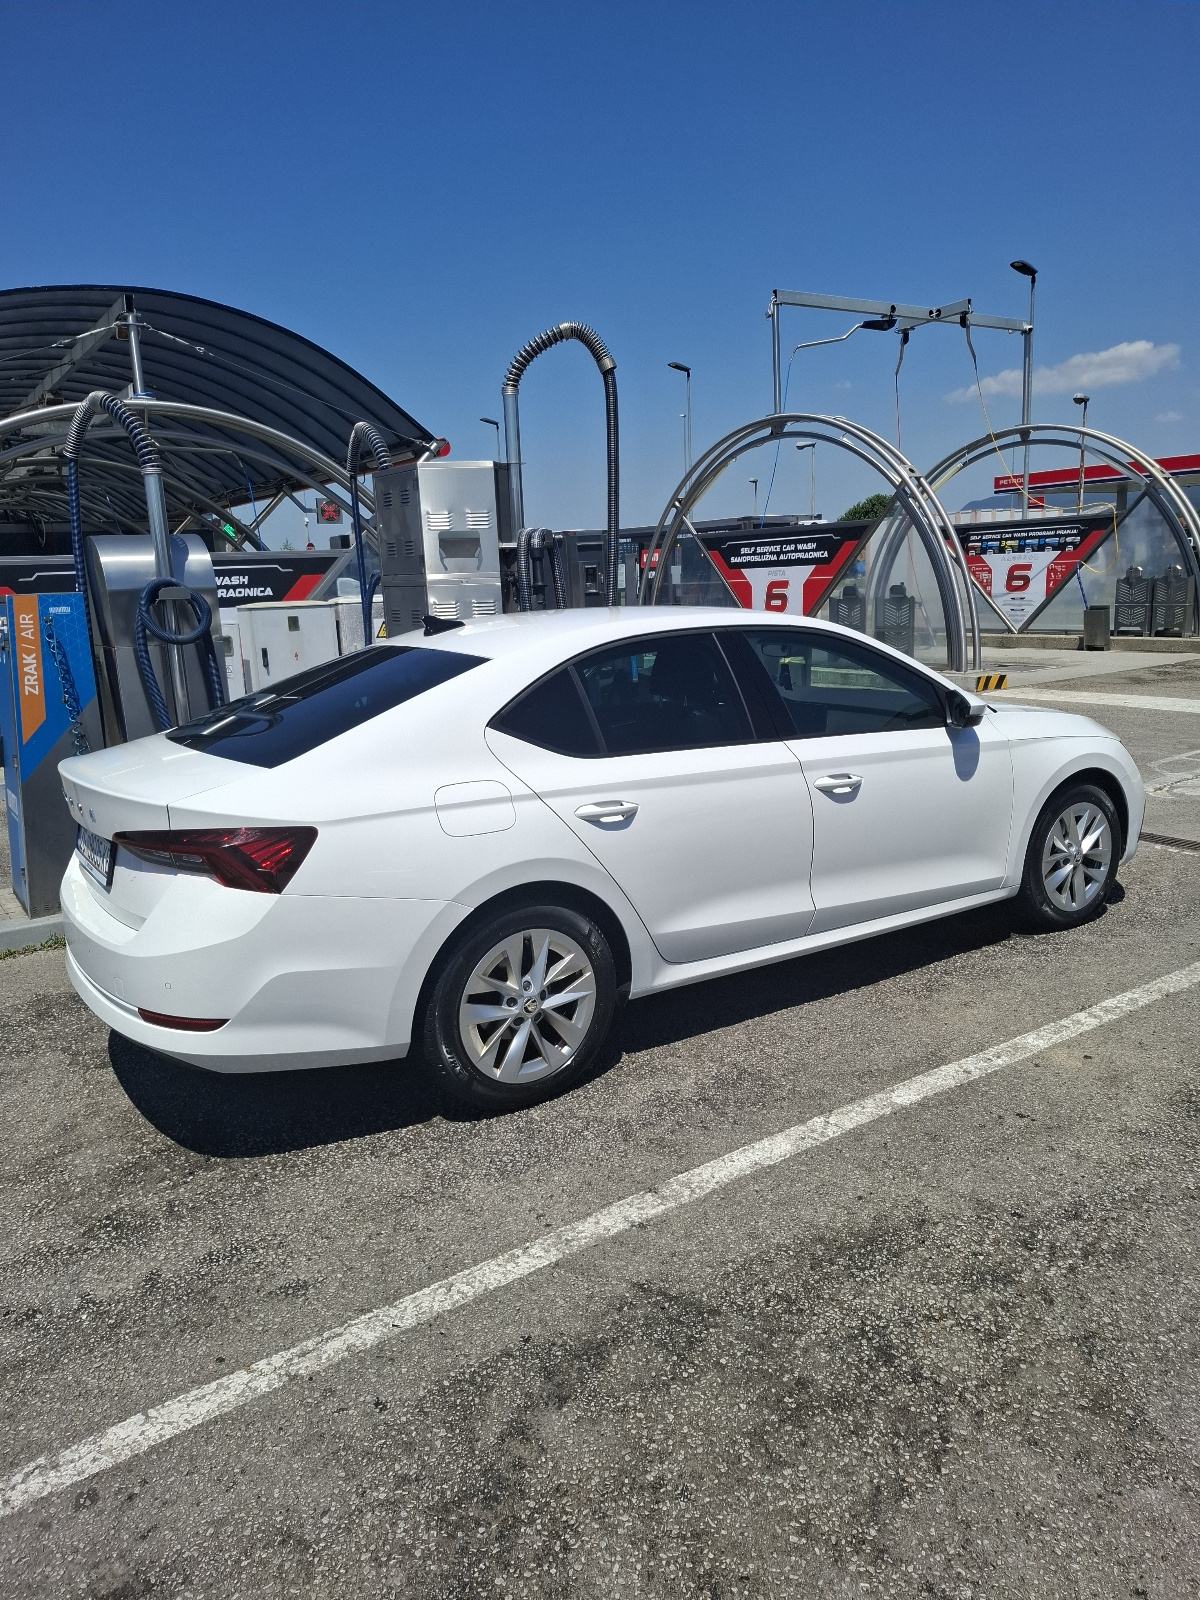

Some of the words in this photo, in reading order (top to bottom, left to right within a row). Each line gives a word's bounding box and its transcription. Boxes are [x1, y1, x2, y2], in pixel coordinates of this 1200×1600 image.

[999, 477, 1024, 485] PETROL
[756, 545, 781, 553] SERVICE
[782, 544, 795, 552] CAR
[797, 542, 817, 550] WASH
[779, 550, 829, 561] AUTOPRAONICA
[767, 569, 786, 577] PISTA
[1004, 562, 1034, 593] 6
[216, 587, 274, 598] RAONICA
[764, 579, 790, 614] 6
[19, 614, 35, 640] AIR
[22, 653, 39, 696] ZRAK
